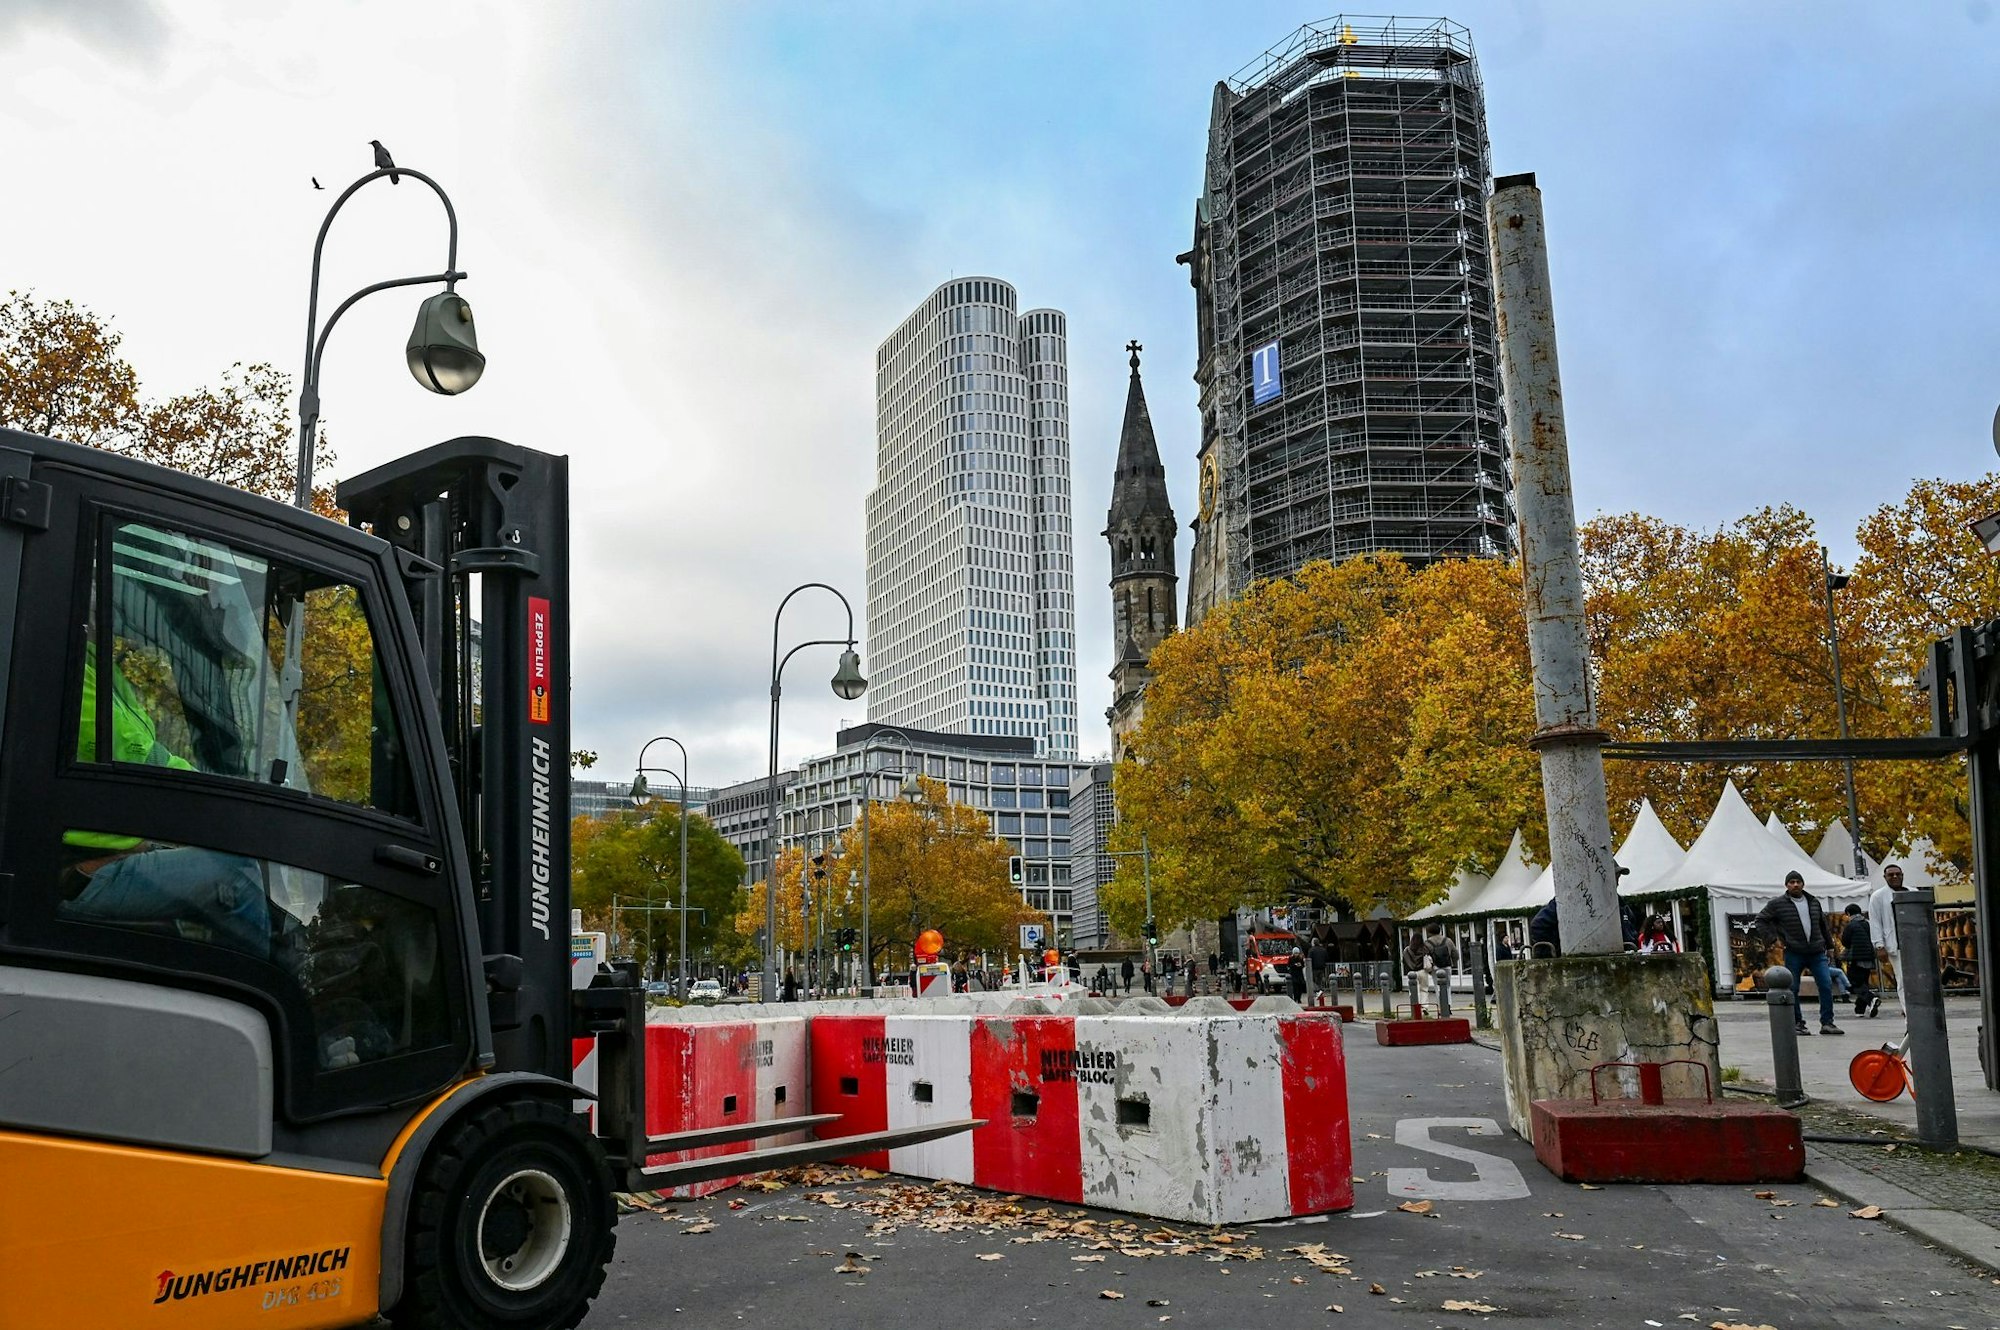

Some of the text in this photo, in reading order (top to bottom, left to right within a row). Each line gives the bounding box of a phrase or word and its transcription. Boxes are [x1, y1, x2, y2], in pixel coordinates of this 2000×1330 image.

[535, 612, 544, 679] ZEPPELIN
[532, 736, 550, 940] JUNGHEINRICH
[863, 1037, 914, 1053] NIEMEIER
[1041, 1049, 1115, 1069] NIEMEIER
